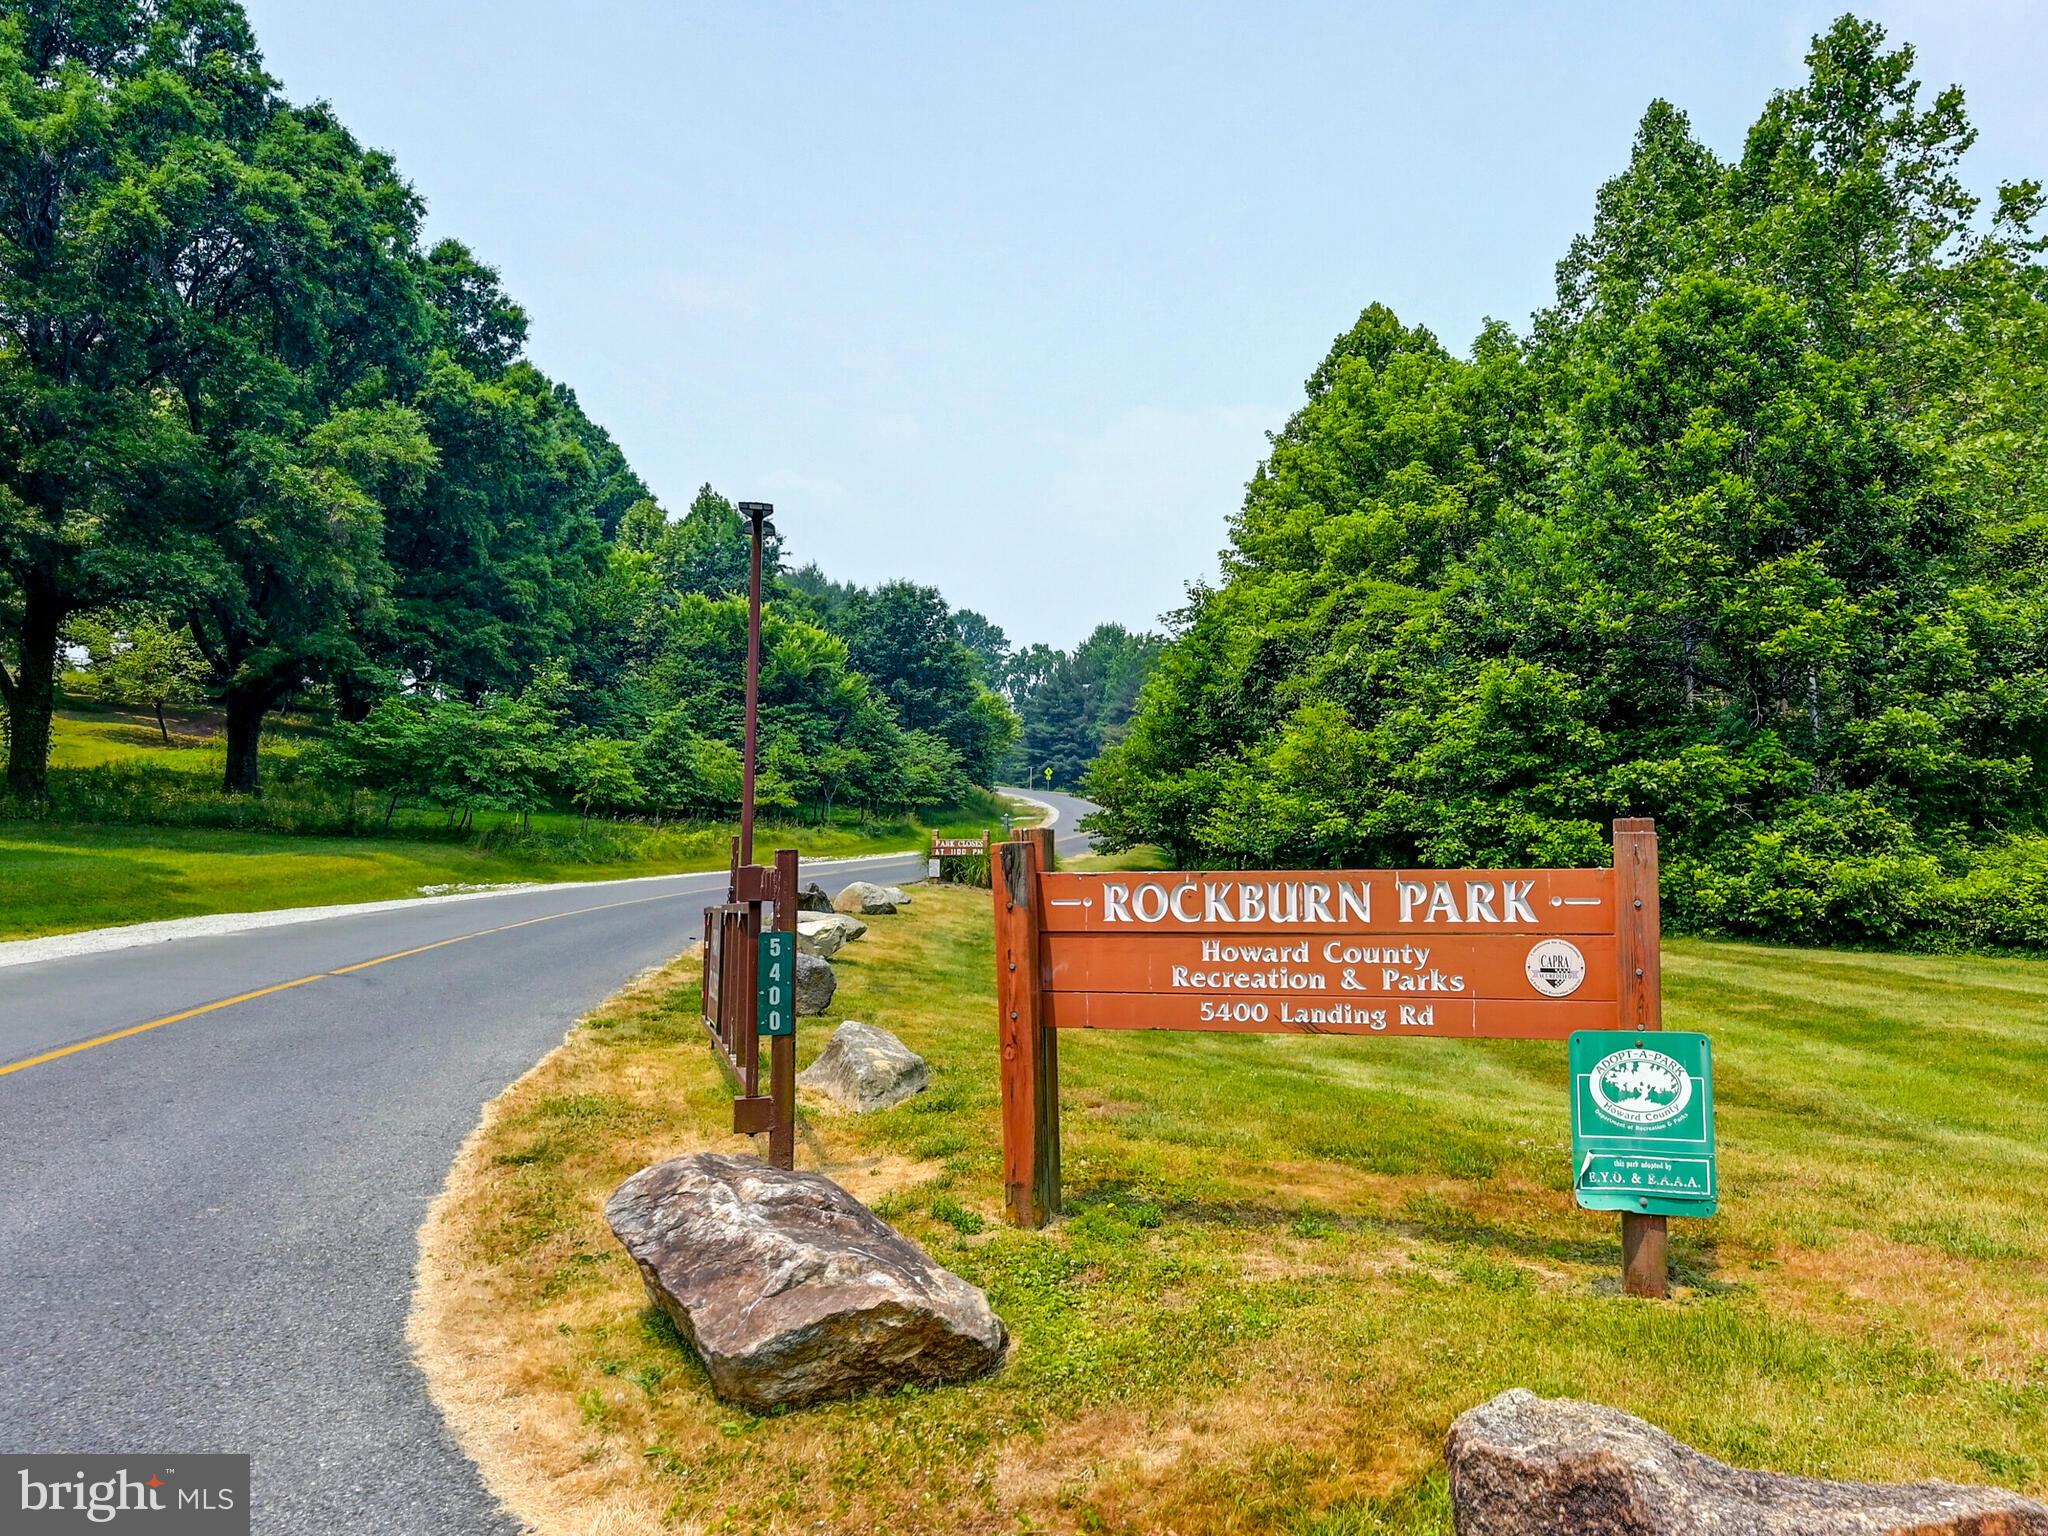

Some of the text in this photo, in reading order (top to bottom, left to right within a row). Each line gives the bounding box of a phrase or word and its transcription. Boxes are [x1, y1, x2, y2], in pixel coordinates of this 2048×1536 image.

[935, 840, 984, 848] PARK CLOSES
[1102, 881, 1539, 923] ROCKBURN PARK
[1201, 940, 1430, 968] Howard County
[1540, 954, 1569, 968] CAPRA
[769, 938, 781, 1030] 5400
[1172, 966, 1465, 992] Recreation & Parks
[1201, 1002, 1434, 1030] 5400 Landing Rd
[1596, 1050, 1685, 1077] ADOPT-A-PARK
[1594, 1108, 1626, 1128] Department
[1635, 1124, 1666, 1132] Recreation
[1673, 1113, 1689, 1125] Parks
[1604, 1102, 1679, 1121] Howard County
[1614, 1160, 1672, 1171] this park adopted by
[1631, 1172, 1642, 1185] &
